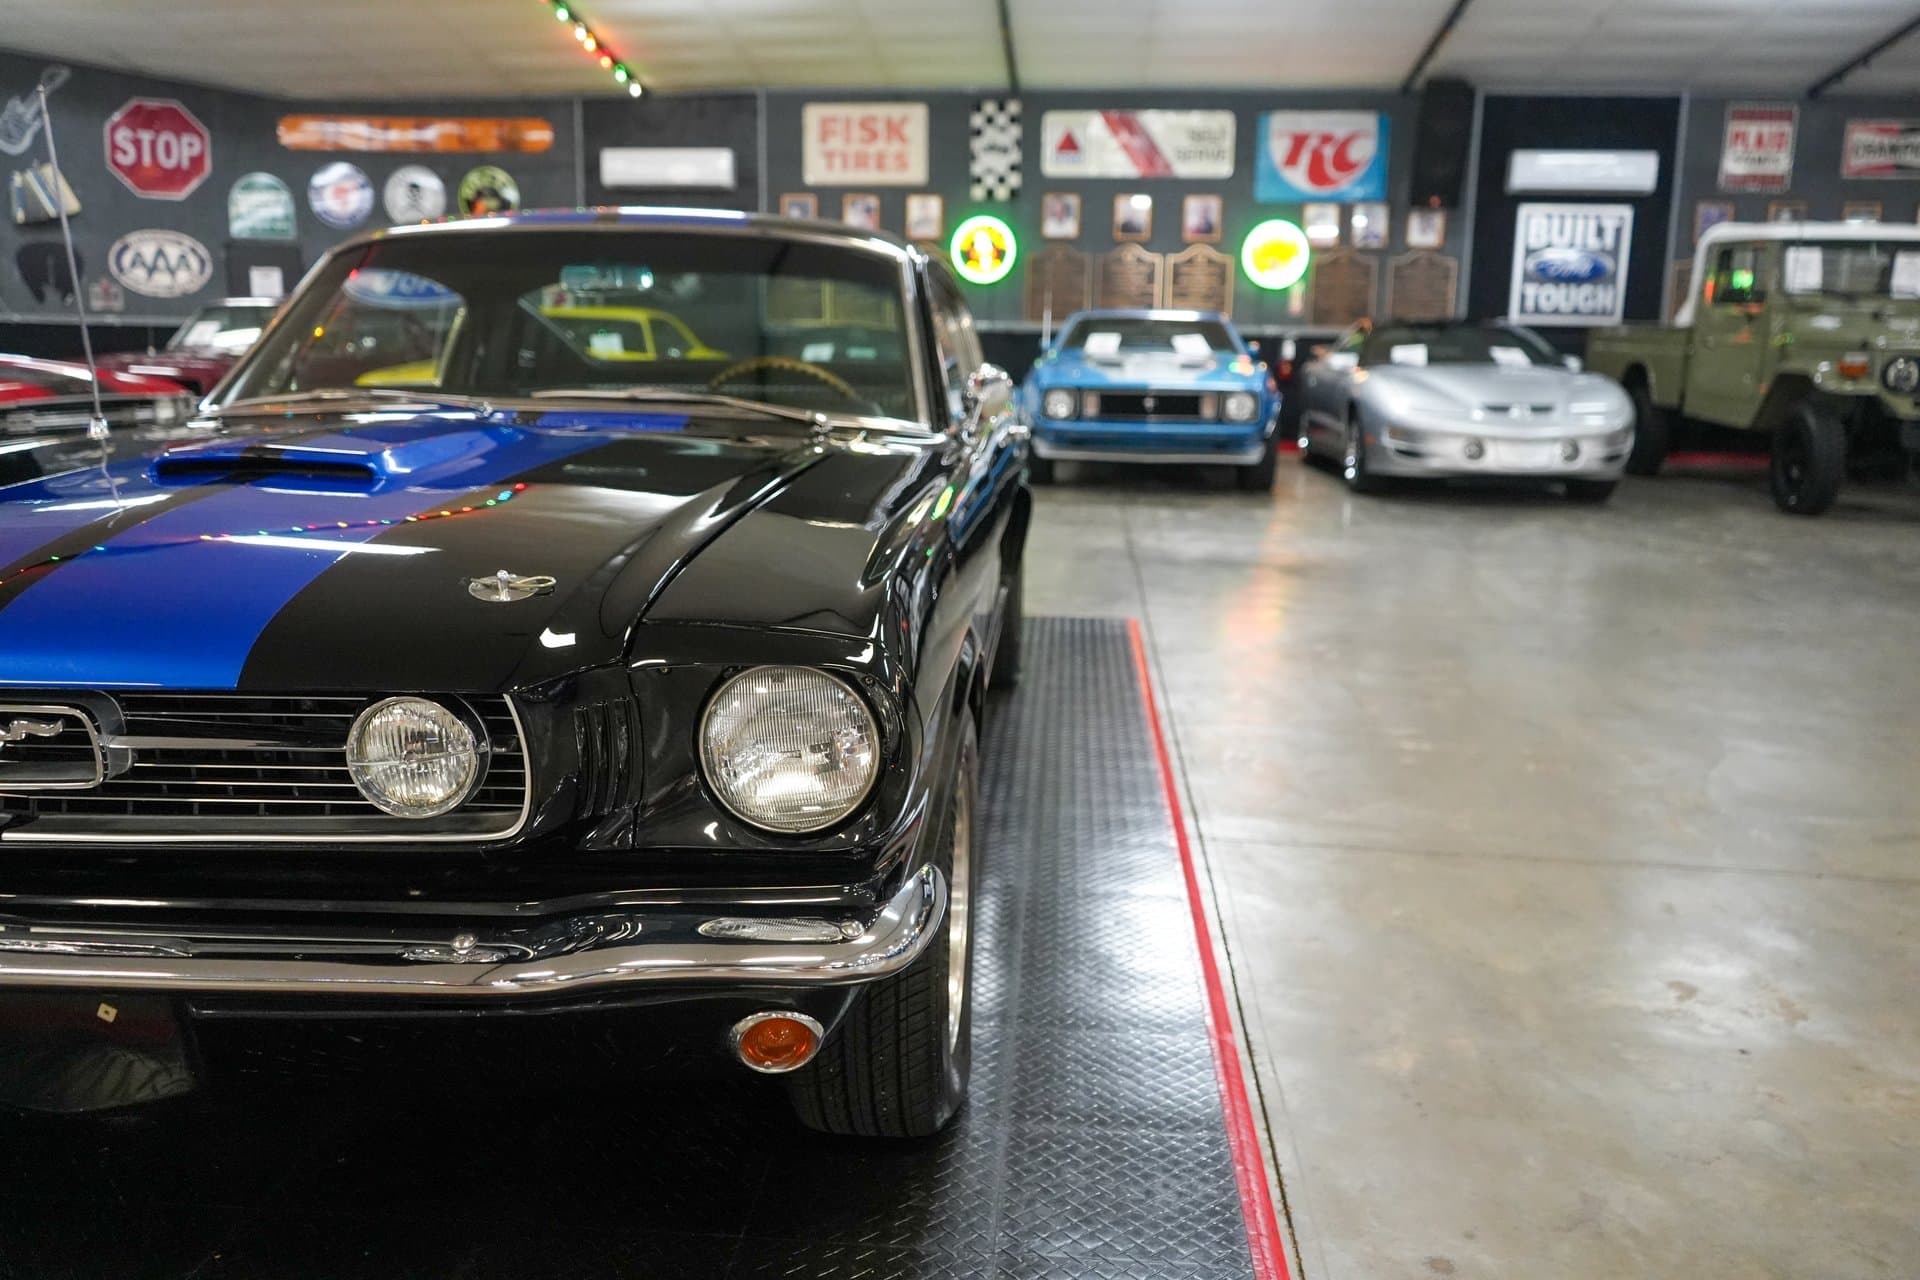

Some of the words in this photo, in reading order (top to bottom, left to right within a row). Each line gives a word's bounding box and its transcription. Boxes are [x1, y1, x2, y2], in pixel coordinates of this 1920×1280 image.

[818, 115, 909, 144] FISK
[113, 126, 202, 171] STOP
[821, 150, 910, 172] TIRES
[1279, 128, 1370, 190] RC
[1526, 214, 1625, 251] BUILT
[131, 248, 192, 280] AAA
[1521, 282, 1616, 314] TOUGH
